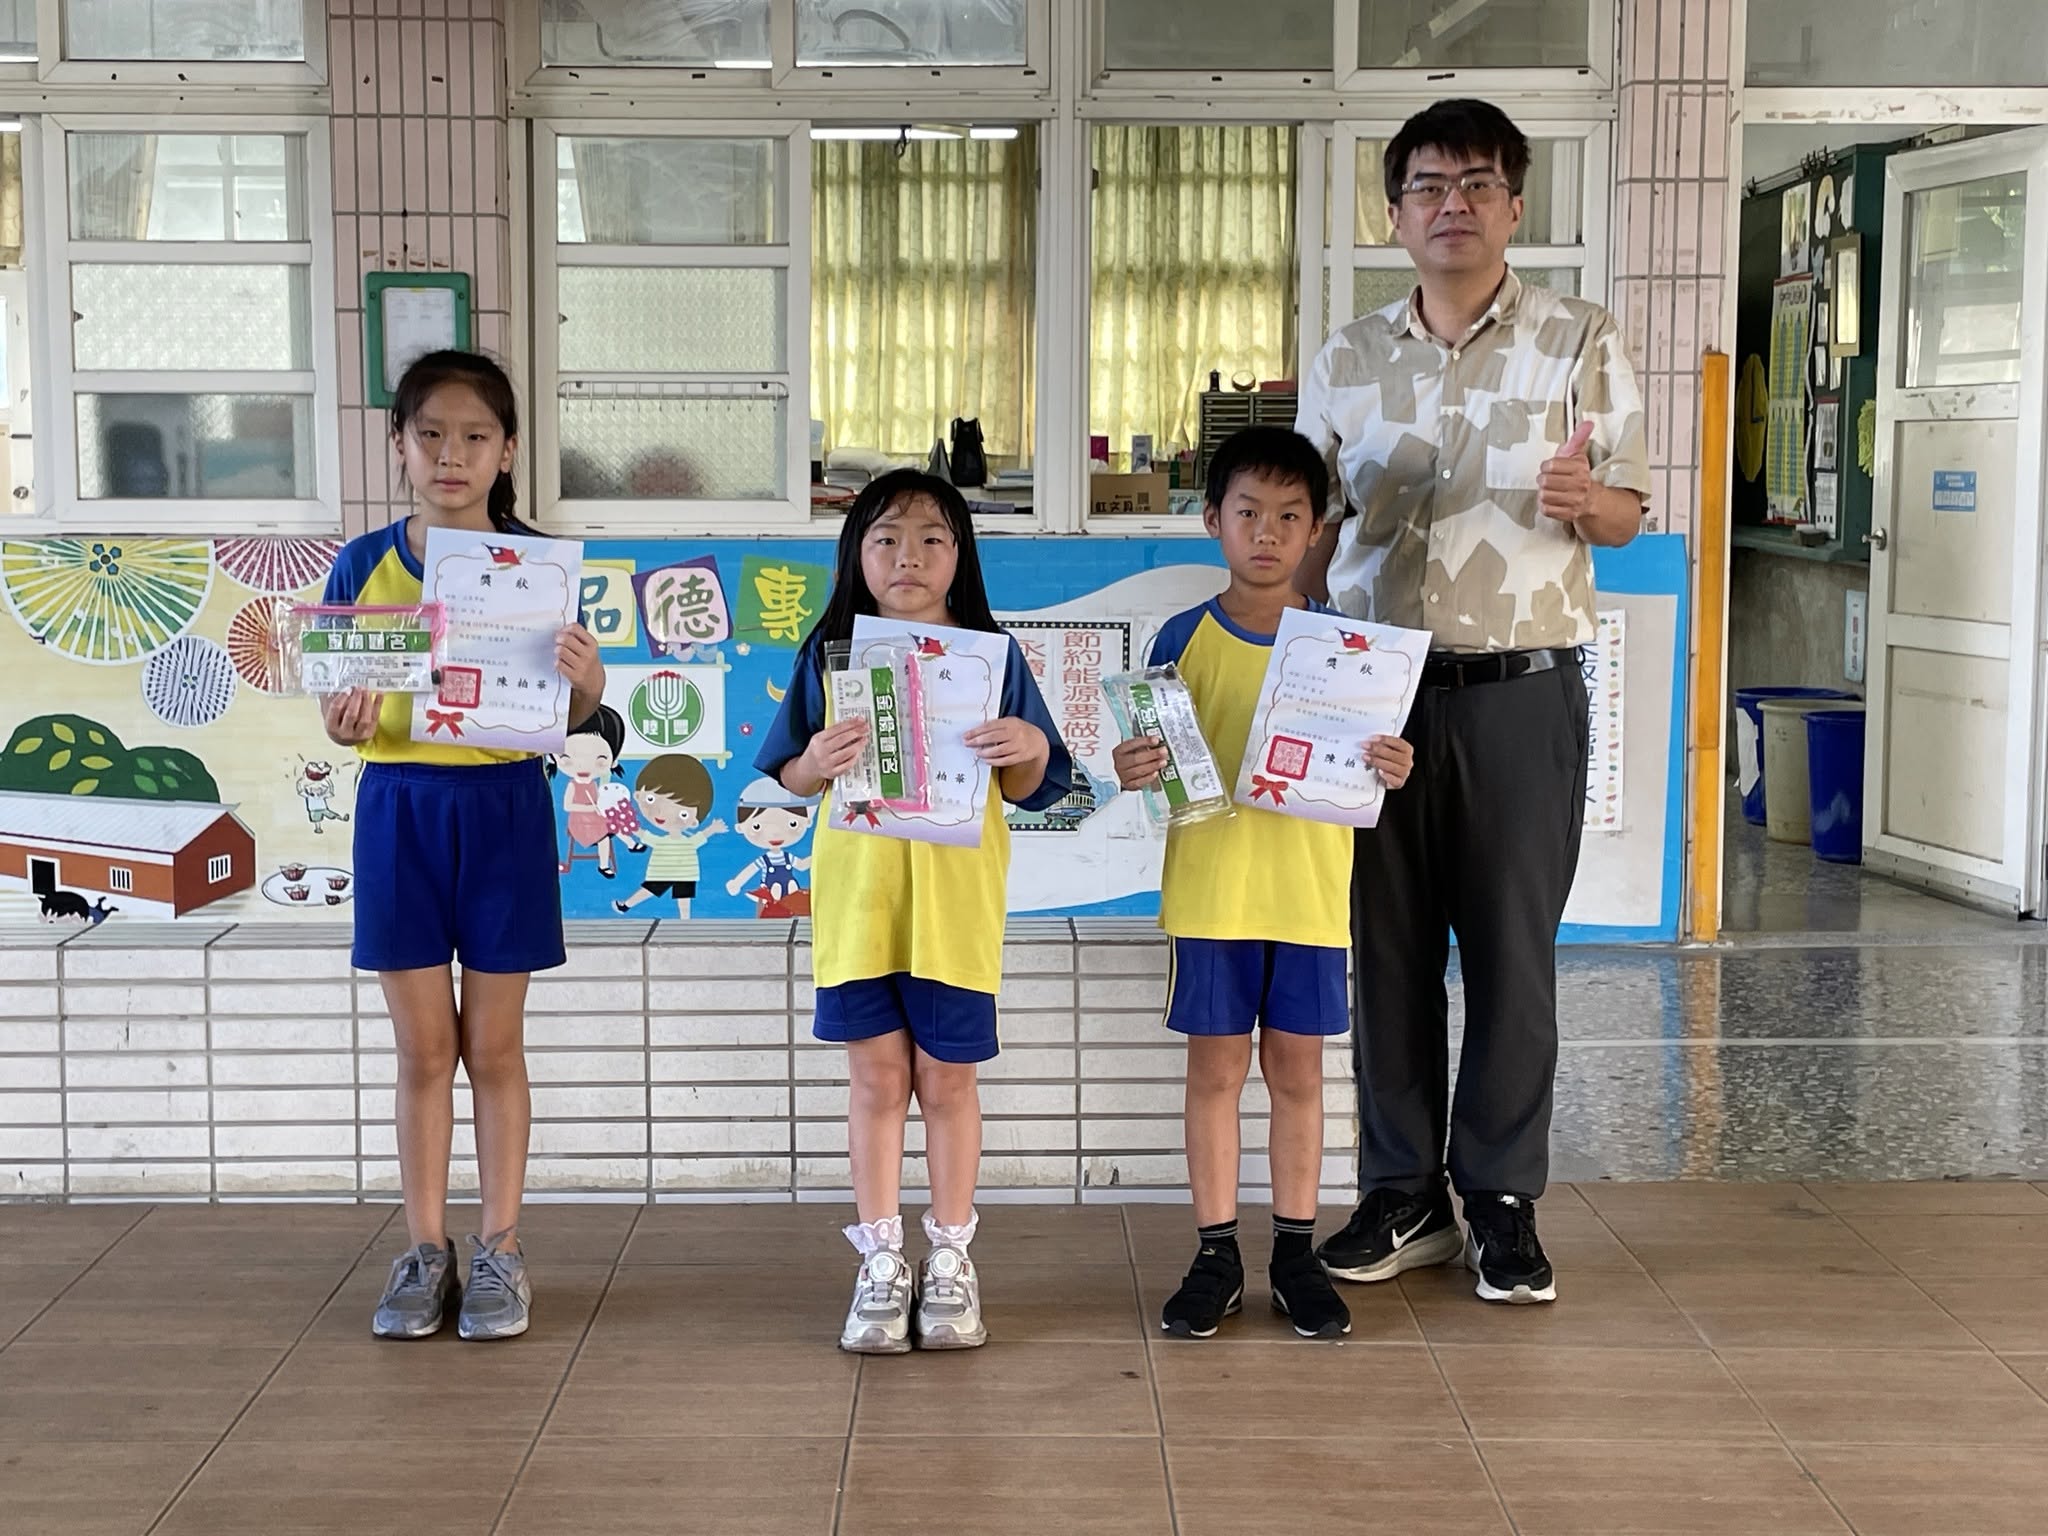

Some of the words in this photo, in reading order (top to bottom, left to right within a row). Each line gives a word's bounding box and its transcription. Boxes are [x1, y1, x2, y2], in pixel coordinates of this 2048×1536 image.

[1063, 631, 1101, 757] 節約能源要做好
